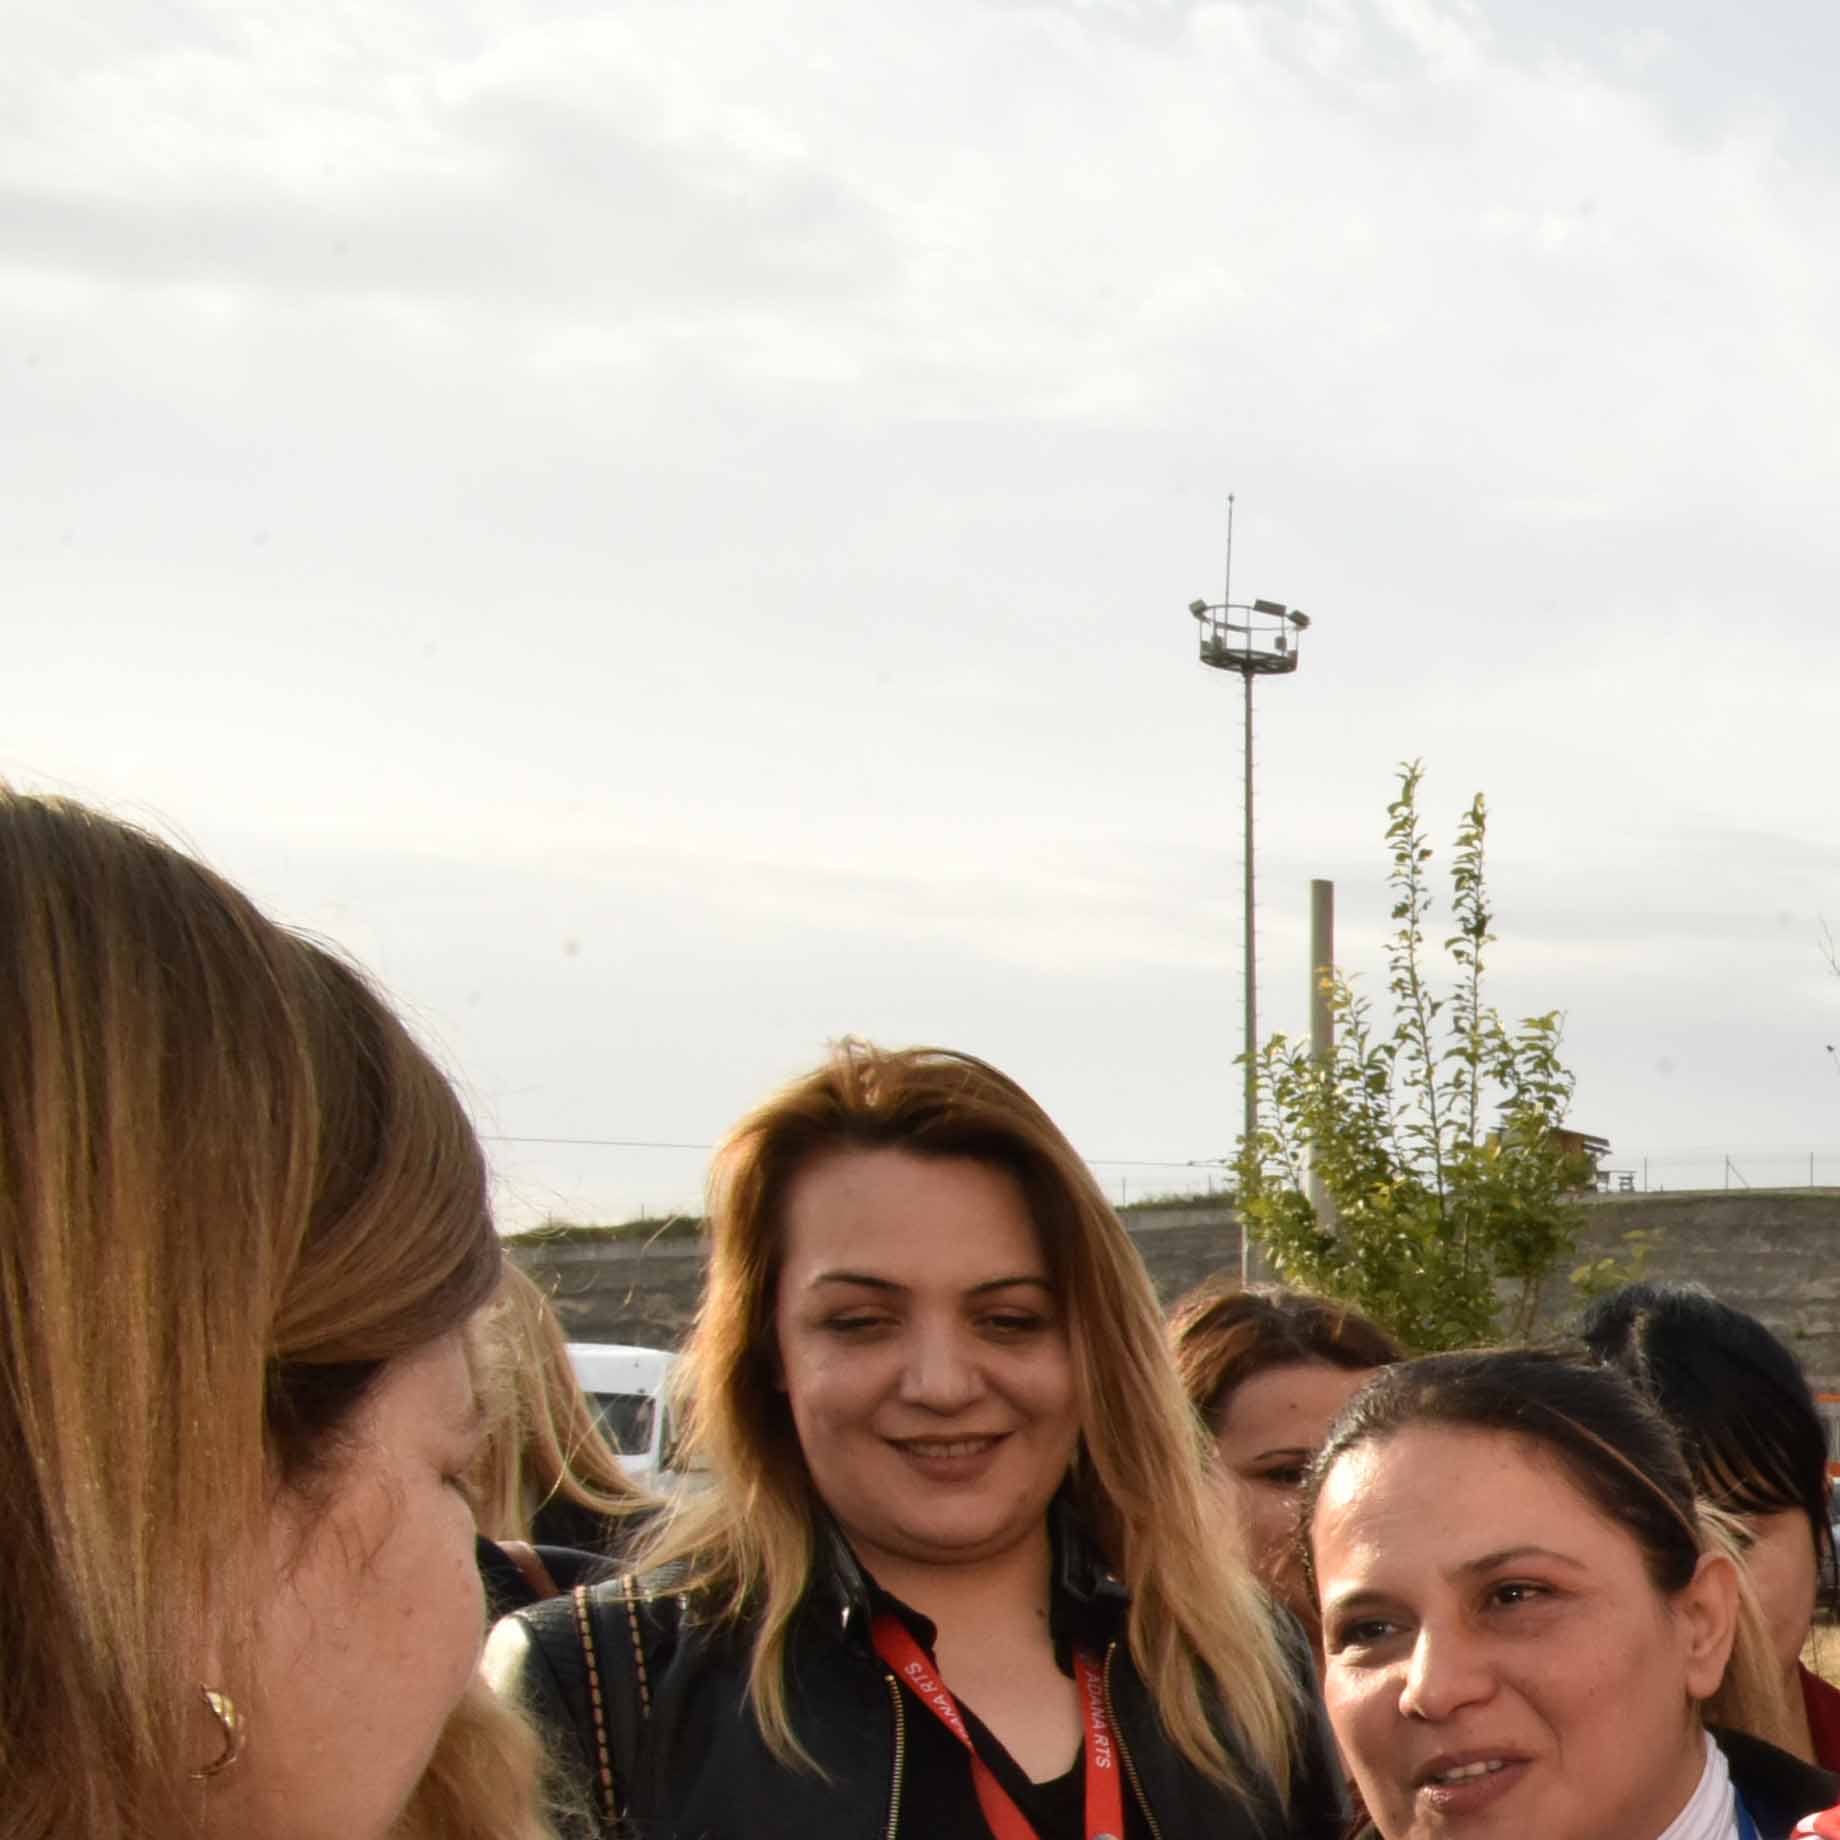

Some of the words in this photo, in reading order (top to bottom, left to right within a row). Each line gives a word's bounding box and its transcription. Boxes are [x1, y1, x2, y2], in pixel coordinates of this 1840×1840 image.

[904, 1662, 941, 1693] RTS
[1086, 1671, 1106, 1729] ADANA
[1094, 1733, 1112, 1769] RTS
